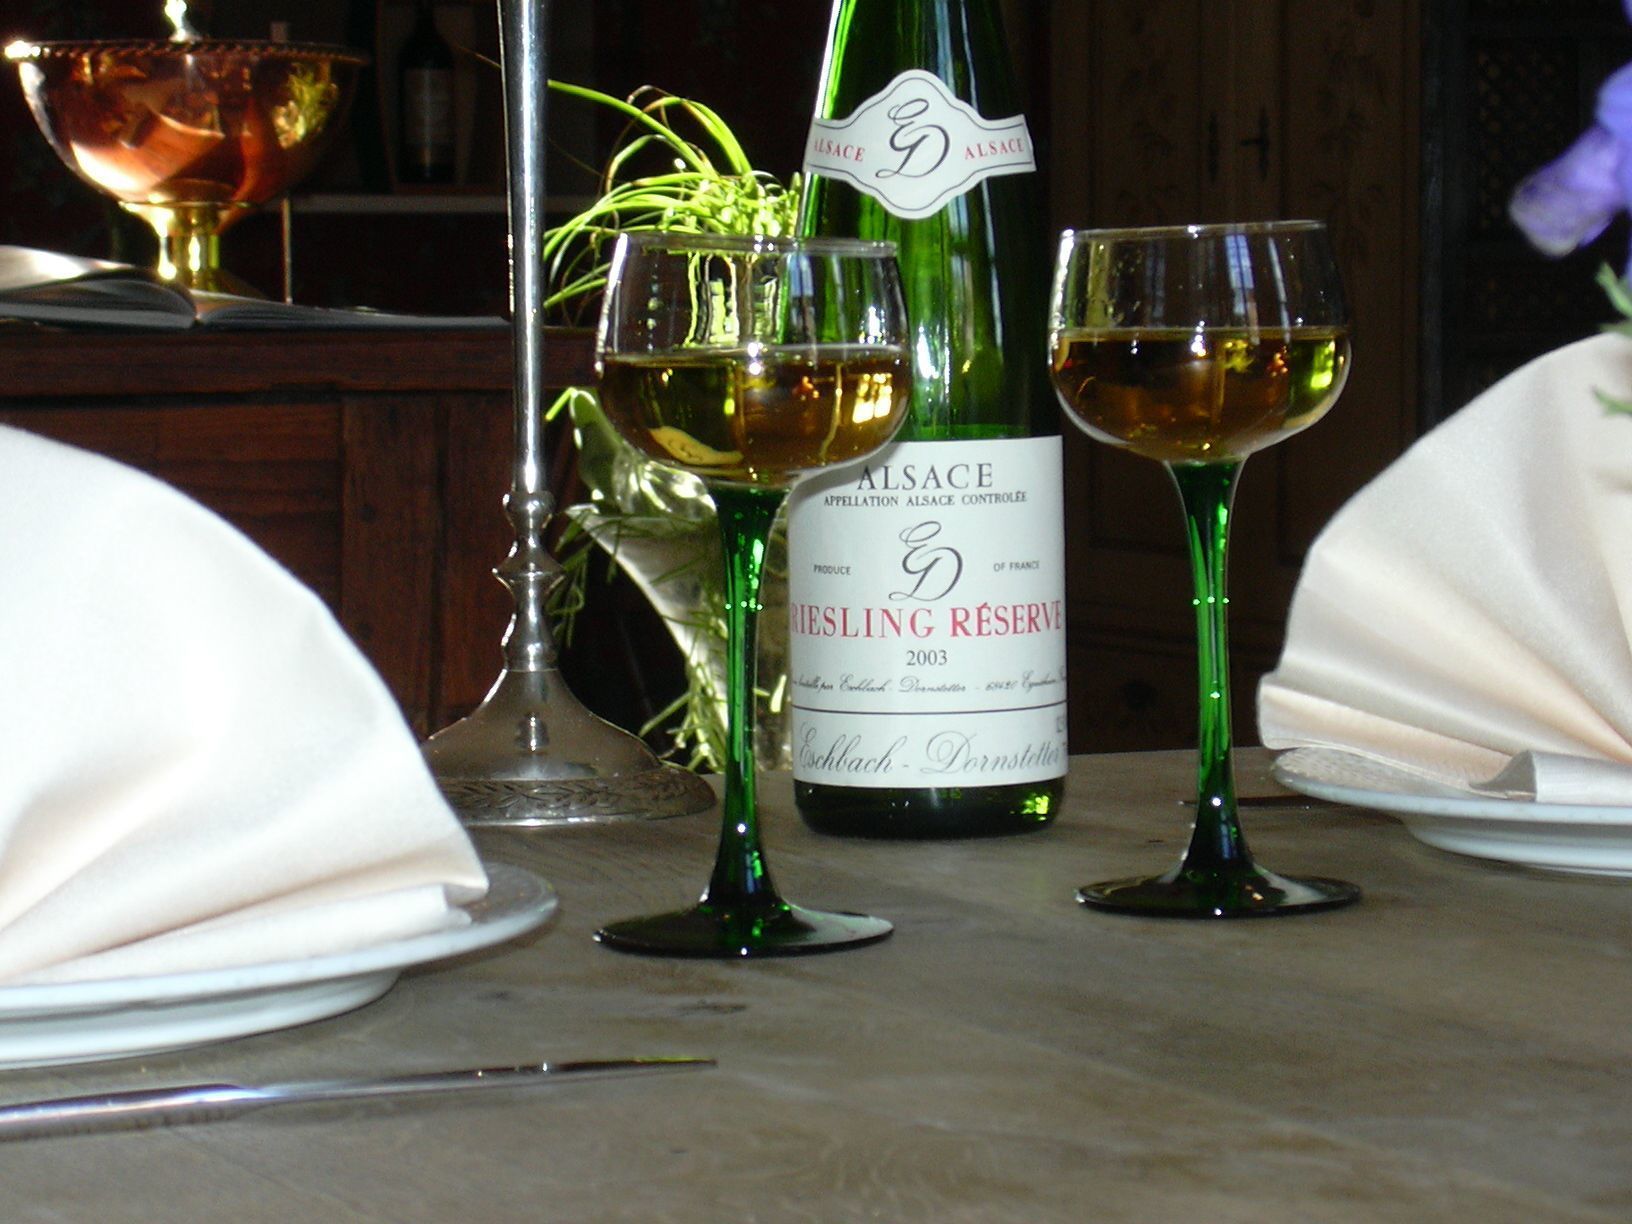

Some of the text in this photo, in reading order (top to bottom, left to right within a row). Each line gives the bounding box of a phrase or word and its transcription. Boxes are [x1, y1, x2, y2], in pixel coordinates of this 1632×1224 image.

[814, 137, 866, 162] ALSACE
[964, 138, 1024, 160] ALSACE
[857, 463, 993, 491] ALSACE
[823, 490, 1028, 508] APPELLATION ALSACE CONTROLÉE
[813, 564, 851, 576] PRODUCE
[993, 560, 1041, 573] OF FRANCE
[790, 600, 1063, 639] RIESLING RÉSERVE
[906, 650, 948, 666] 2003
[799, 726, 907, 774] Eschbach
